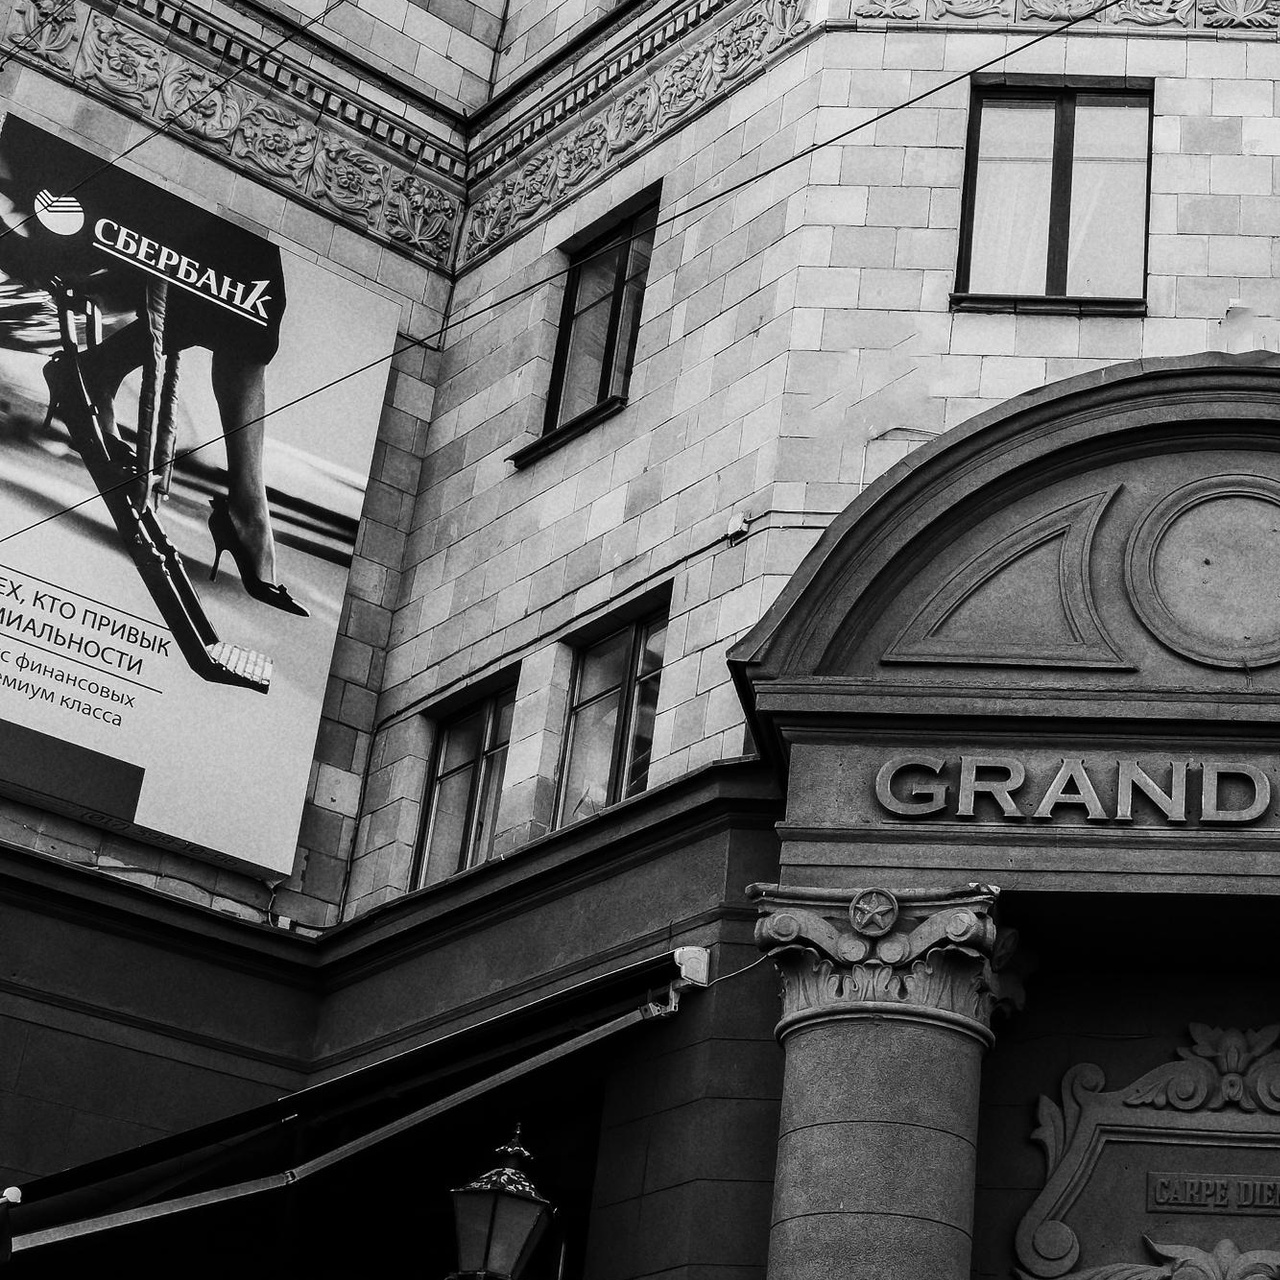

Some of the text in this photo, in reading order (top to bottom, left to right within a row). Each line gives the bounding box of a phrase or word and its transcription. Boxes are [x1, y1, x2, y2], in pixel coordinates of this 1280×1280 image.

[94, 218, 272, 320] СБЕРБАНК
[32, 590, 77, 620] КТО
[81, 608, 172, 657] ПРИВЫК
[15, 652, 136, 708] финансовых
[60, 695, 123, 727] класса
[875, 754, 1271, 824] GRAND
[1154, 1178, 1229, 1208] CARPE
